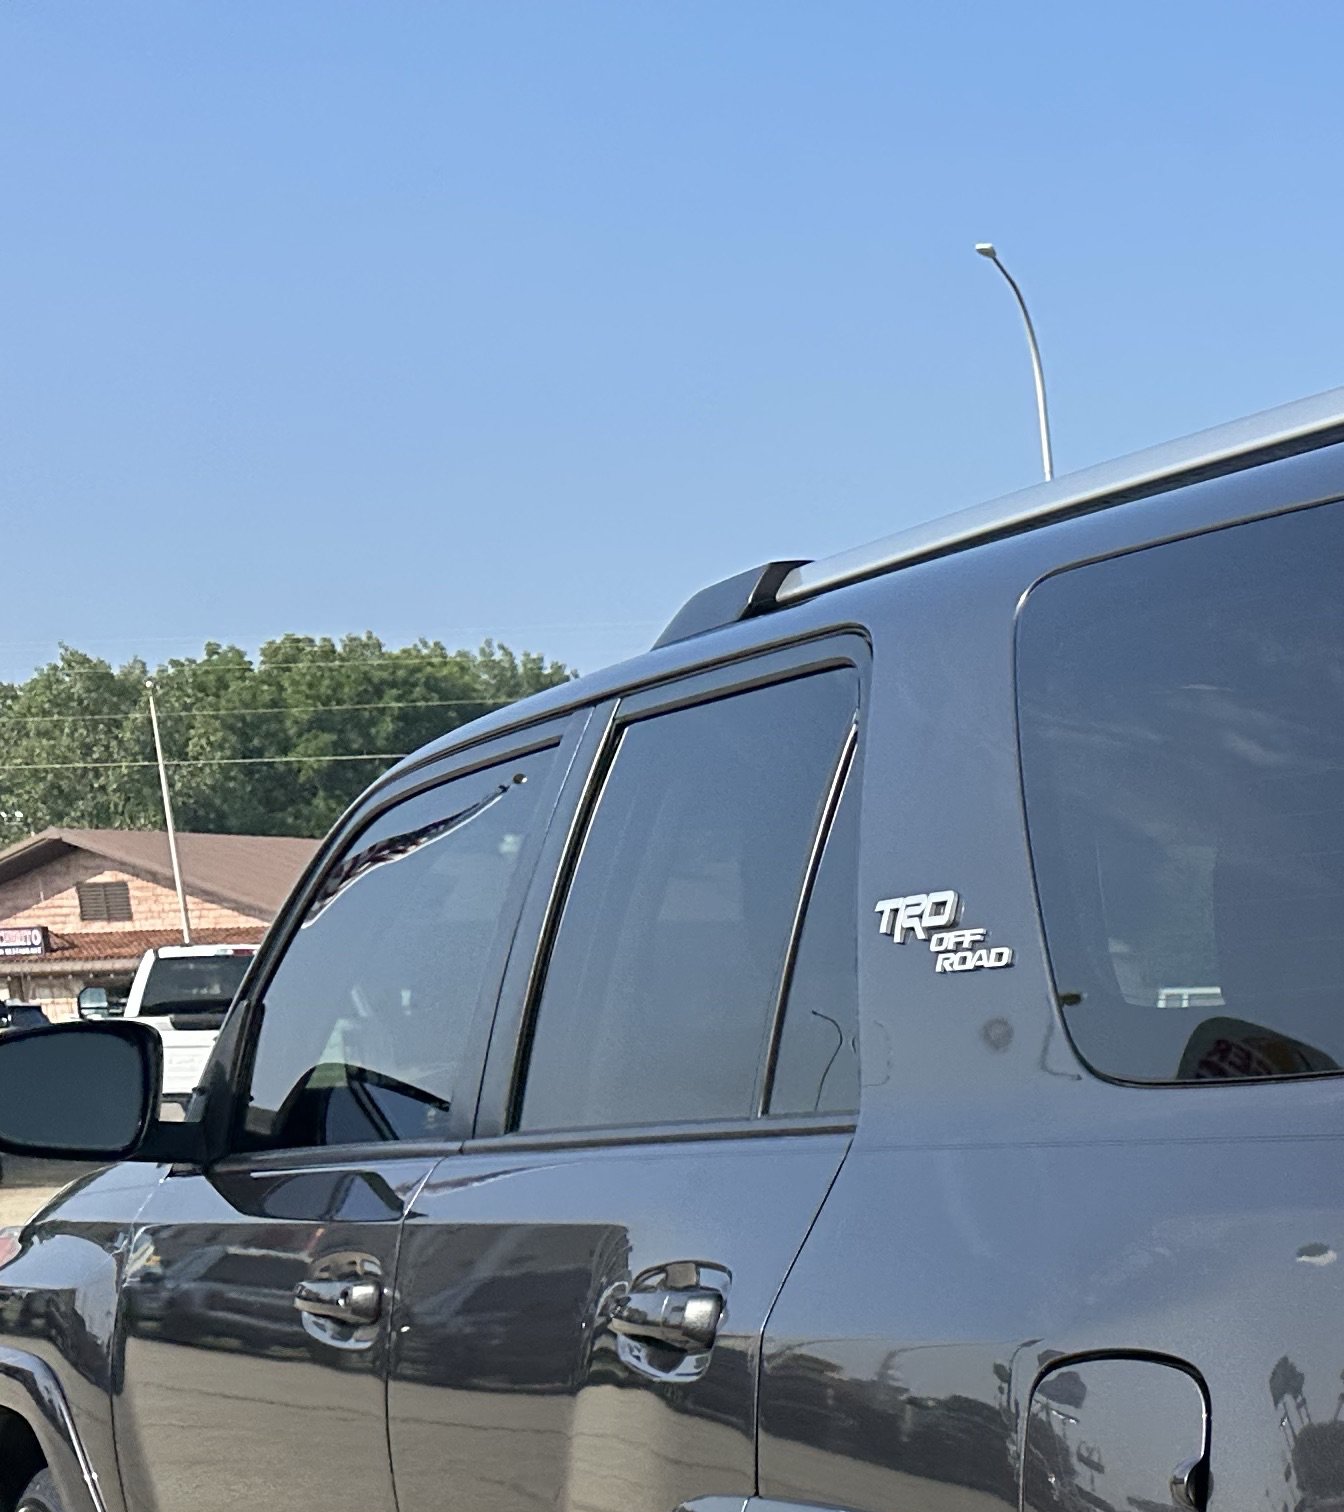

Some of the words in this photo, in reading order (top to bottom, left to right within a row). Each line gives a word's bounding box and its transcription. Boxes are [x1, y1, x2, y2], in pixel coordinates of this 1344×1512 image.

[875, 890, 959, 944] TRD
[929, 928, 988, 952] OFF
[935, 946, 1014, 973] ROAD
